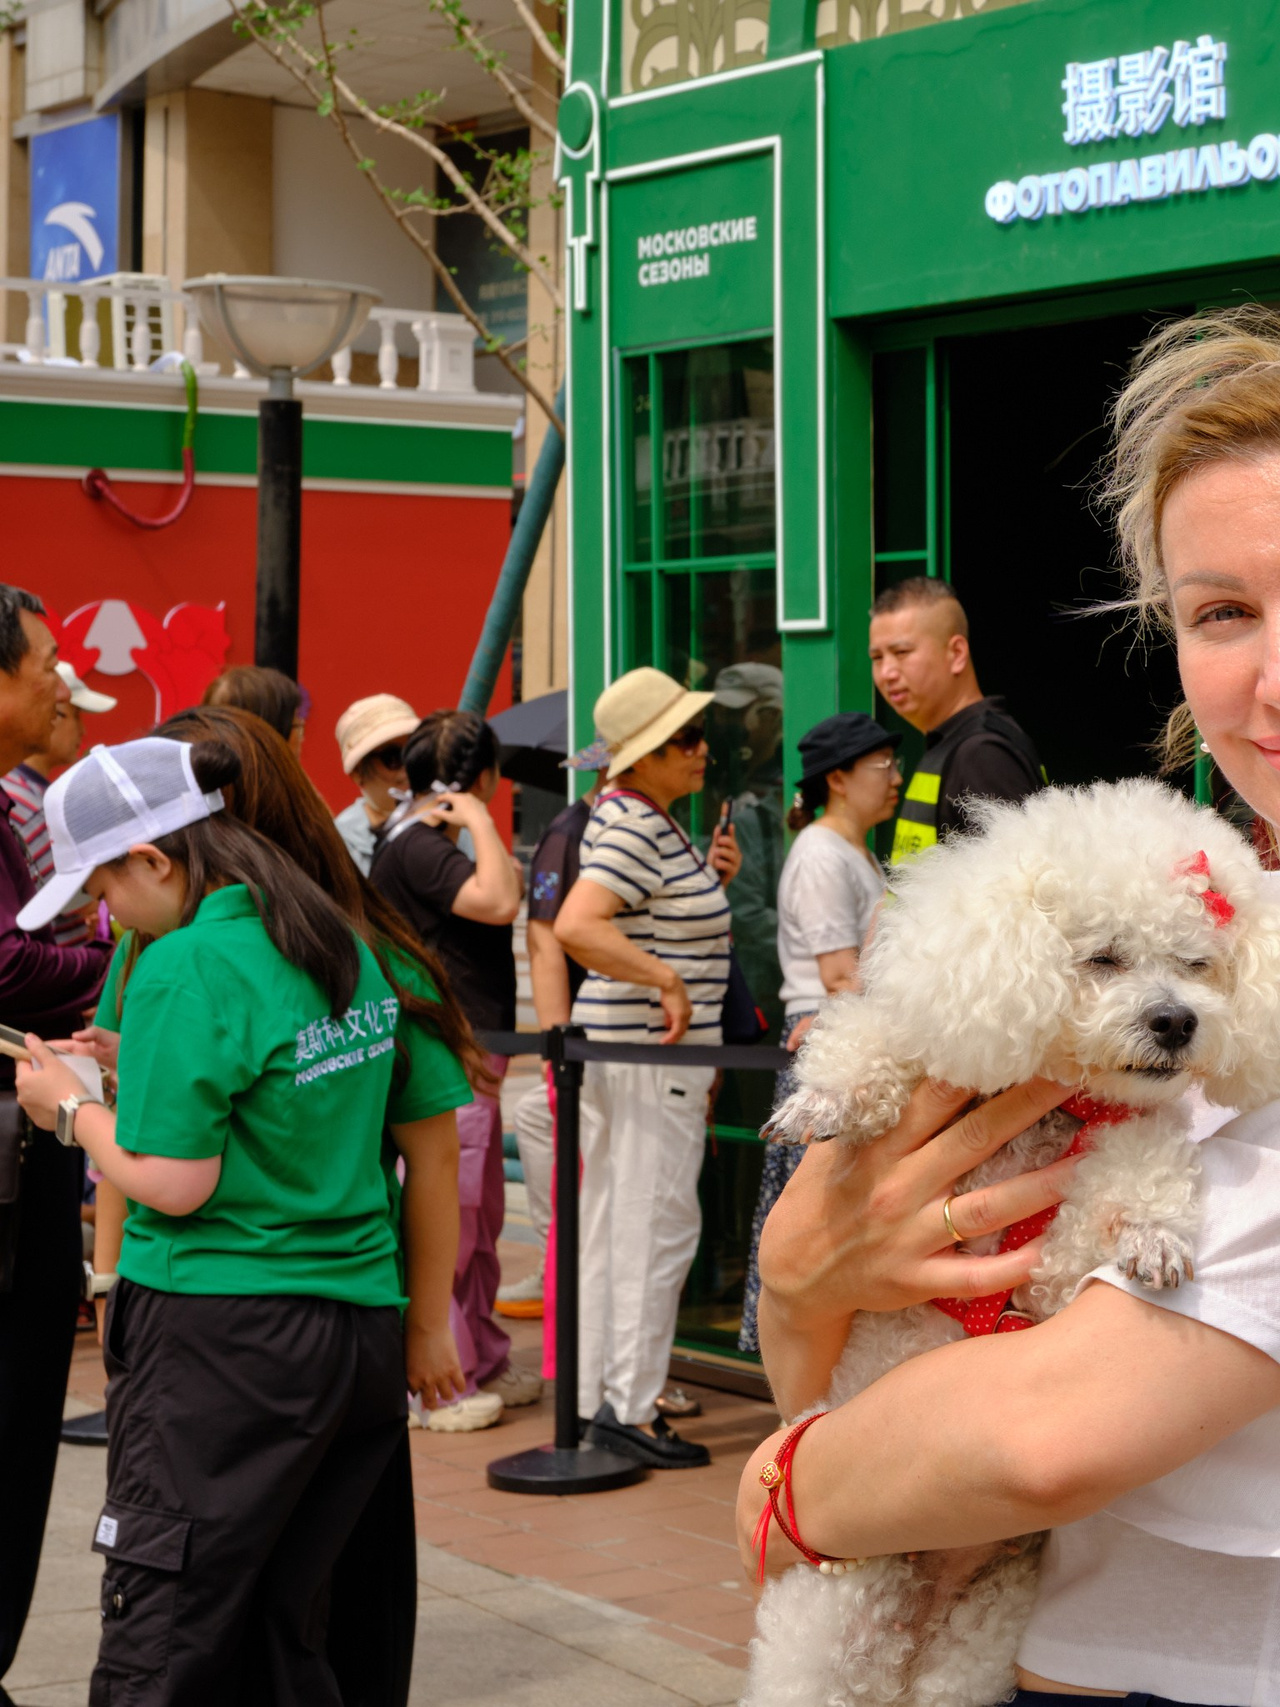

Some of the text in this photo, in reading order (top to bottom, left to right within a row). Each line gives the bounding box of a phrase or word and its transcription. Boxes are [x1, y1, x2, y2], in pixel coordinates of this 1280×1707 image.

[1061, 34, 1227, 145] 摄影馆
[637, 215, 757, 260] МОСКОВСКИЕ
[638, 252, 710, 288] СЕЗОНЫ
[295, 997, 398, 1064] 莫斯科文化节
